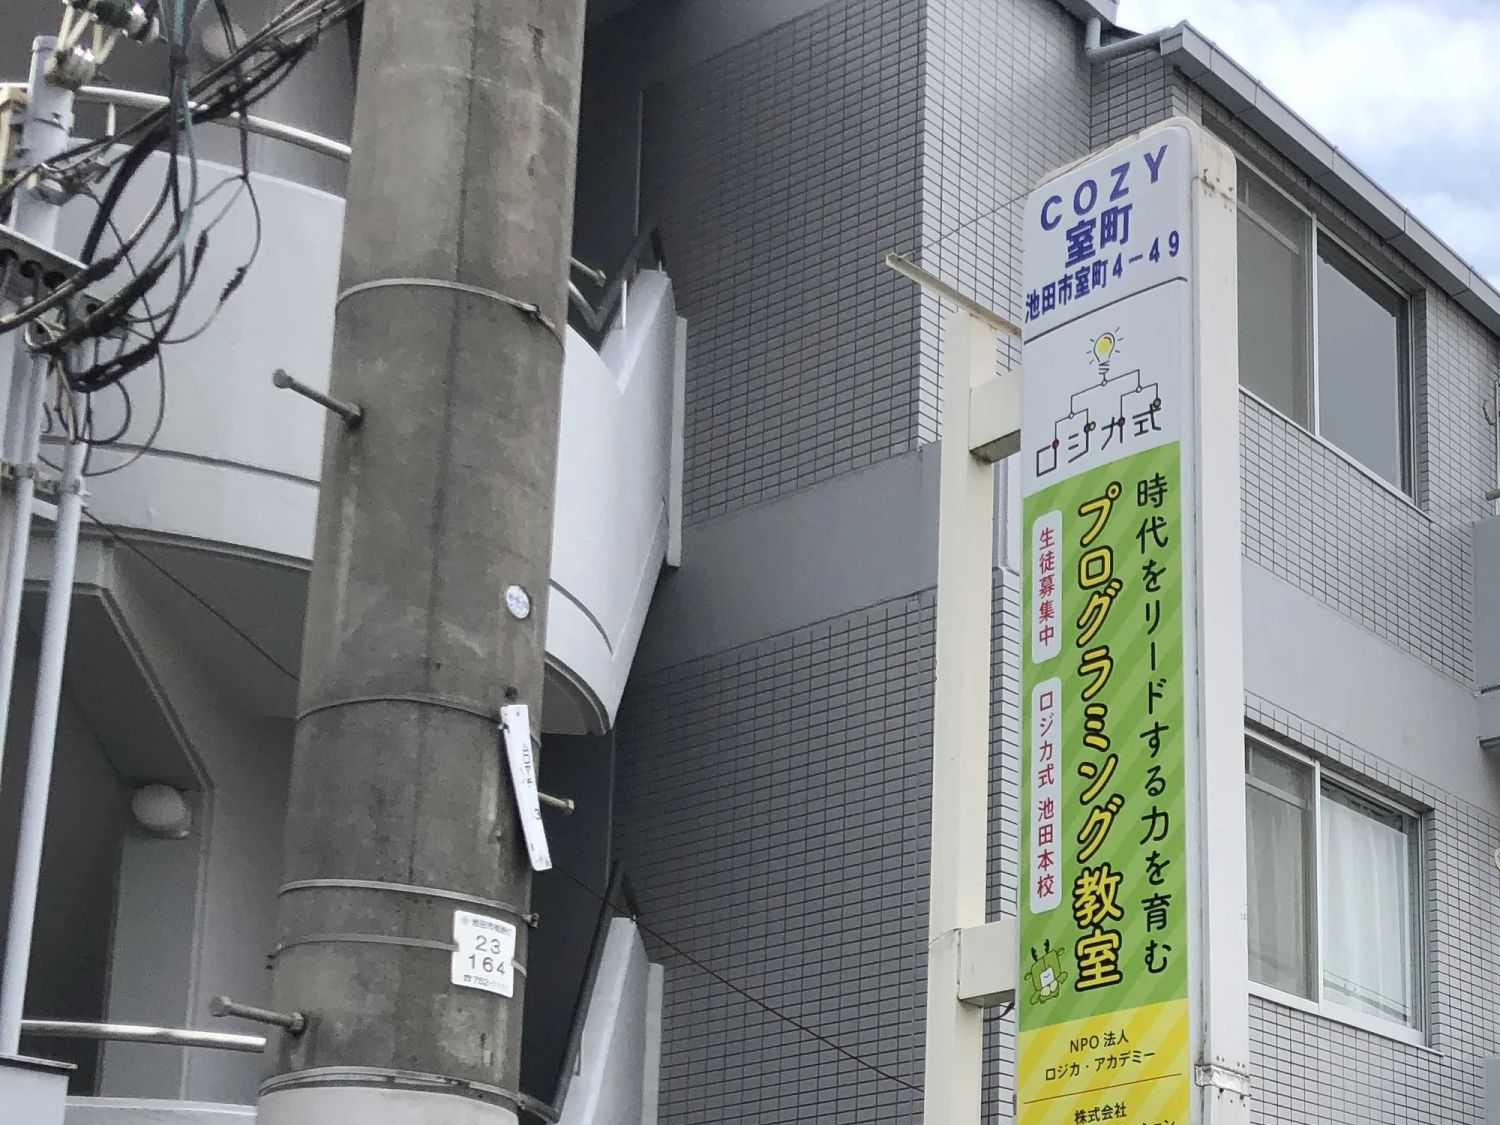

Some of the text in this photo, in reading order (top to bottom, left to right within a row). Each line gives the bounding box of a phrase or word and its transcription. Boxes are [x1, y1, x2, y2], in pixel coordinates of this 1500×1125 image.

[1040, 144, 1168, 231] COZY
[1064, 203, 1133, 269] 室町
[1036, 403, 1162, 478] ロジカ式
[1039, 527, 1055, 647] 生徒募集中
[1072, 481, 1127, 992] プログラミング教室
[1136, 472, 1172, 974] 時代をリードする力を育む
[468, 954, 506, 975] 164
[475, 935, 501, 955] 23
[1074, 1102, 1127, 1125] 株式会社
